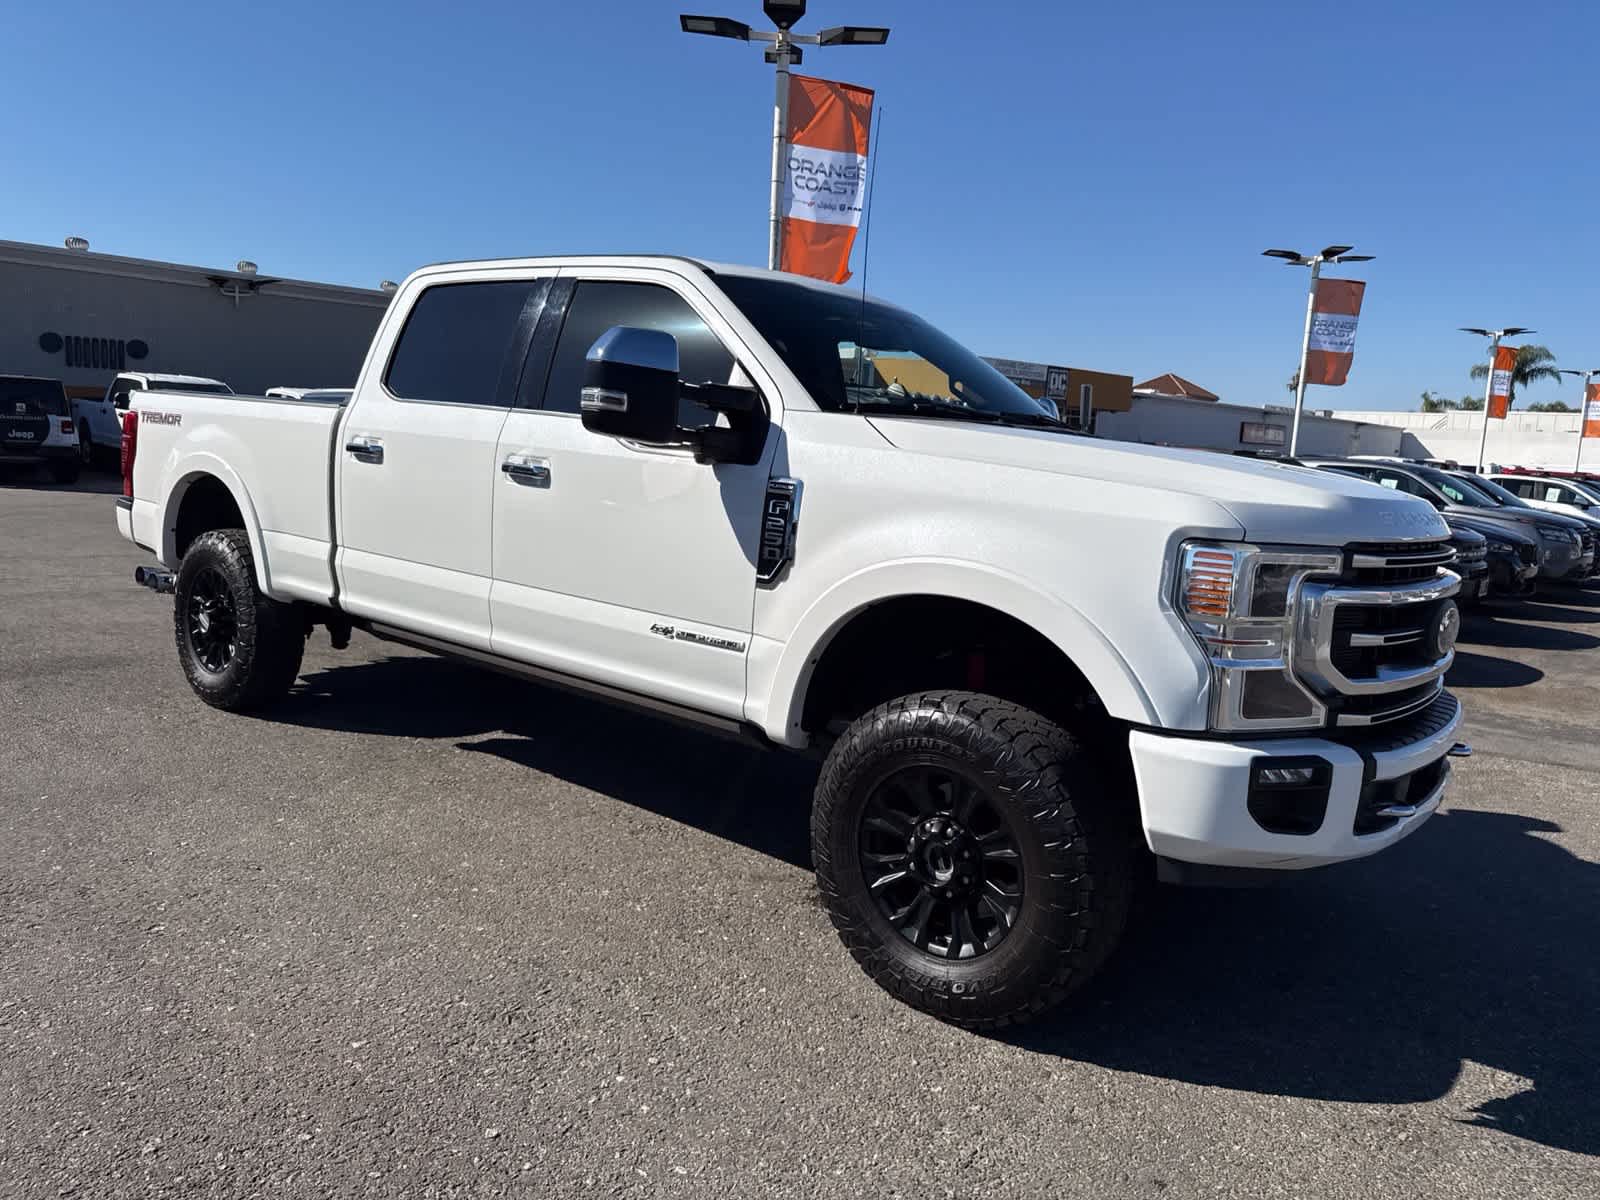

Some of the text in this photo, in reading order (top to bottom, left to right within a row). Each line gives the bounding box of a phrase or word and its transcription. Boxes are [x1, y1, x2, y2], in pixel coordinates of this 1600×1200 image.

[788, 158, 866, 181] ORANGE
[794, 175, 859, 195] COAST
[140, 411, 182, 426] TREMOR
[8, 429, 34, 439] Jeep
